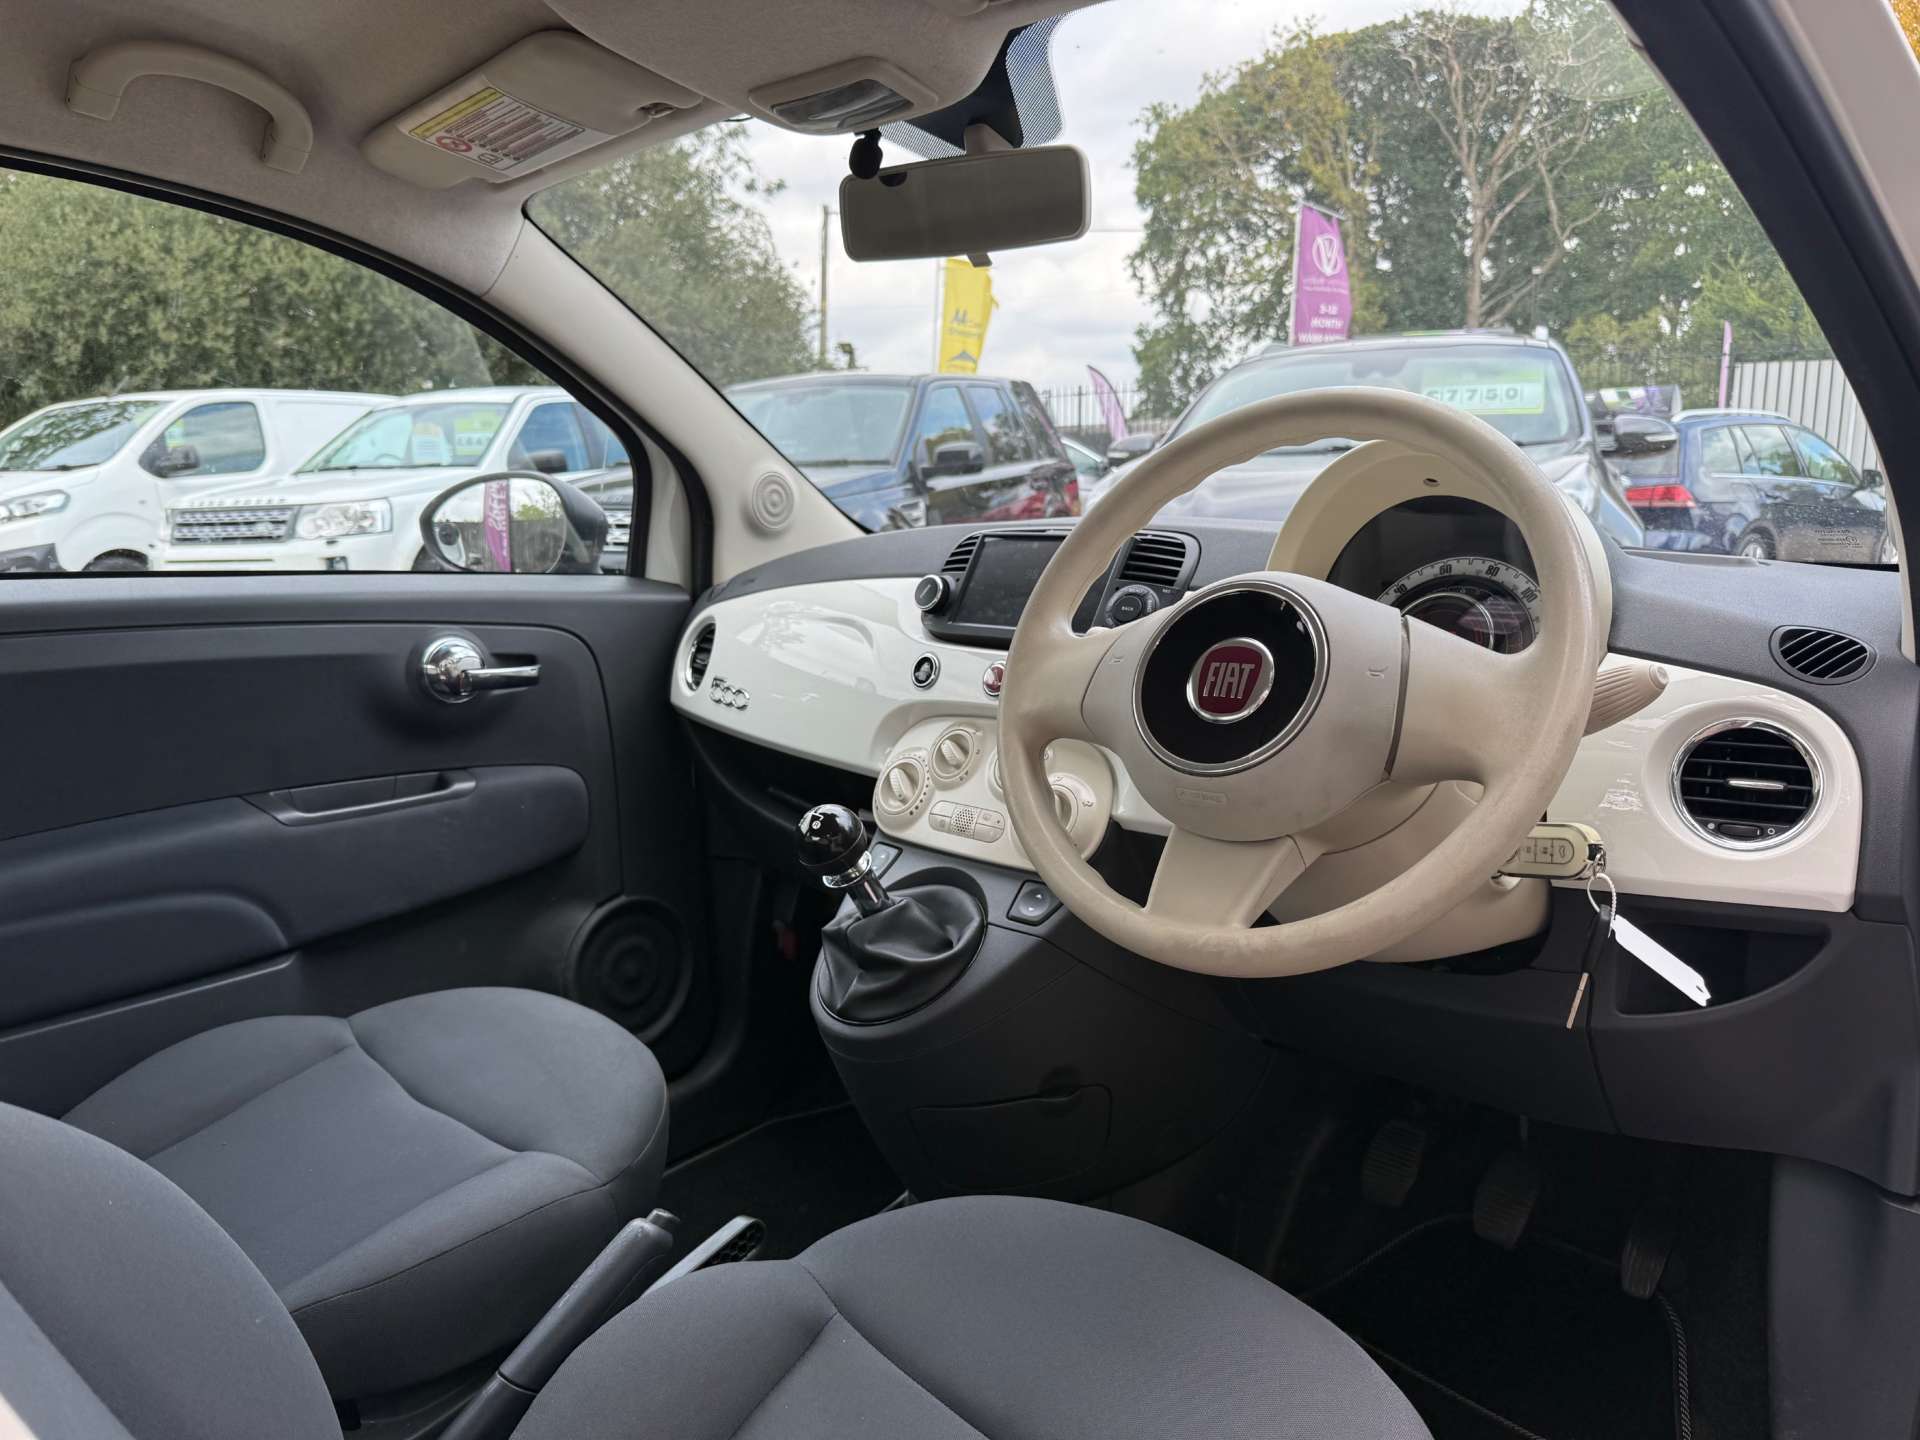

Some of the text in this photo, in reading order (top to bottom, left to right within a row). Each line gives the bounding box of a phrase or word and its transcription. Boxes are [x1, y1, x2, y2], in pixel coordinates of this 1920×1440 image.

[1439, 564, 1453, 575] 60
[1485, 564, 1501, 577] 80
[1393, 583, 1408, 595] 40
[1520, 587, 1538, 603] 100
[1202, 661, 1256, 700] FIAT
[710, 676, 750, 711] 500
